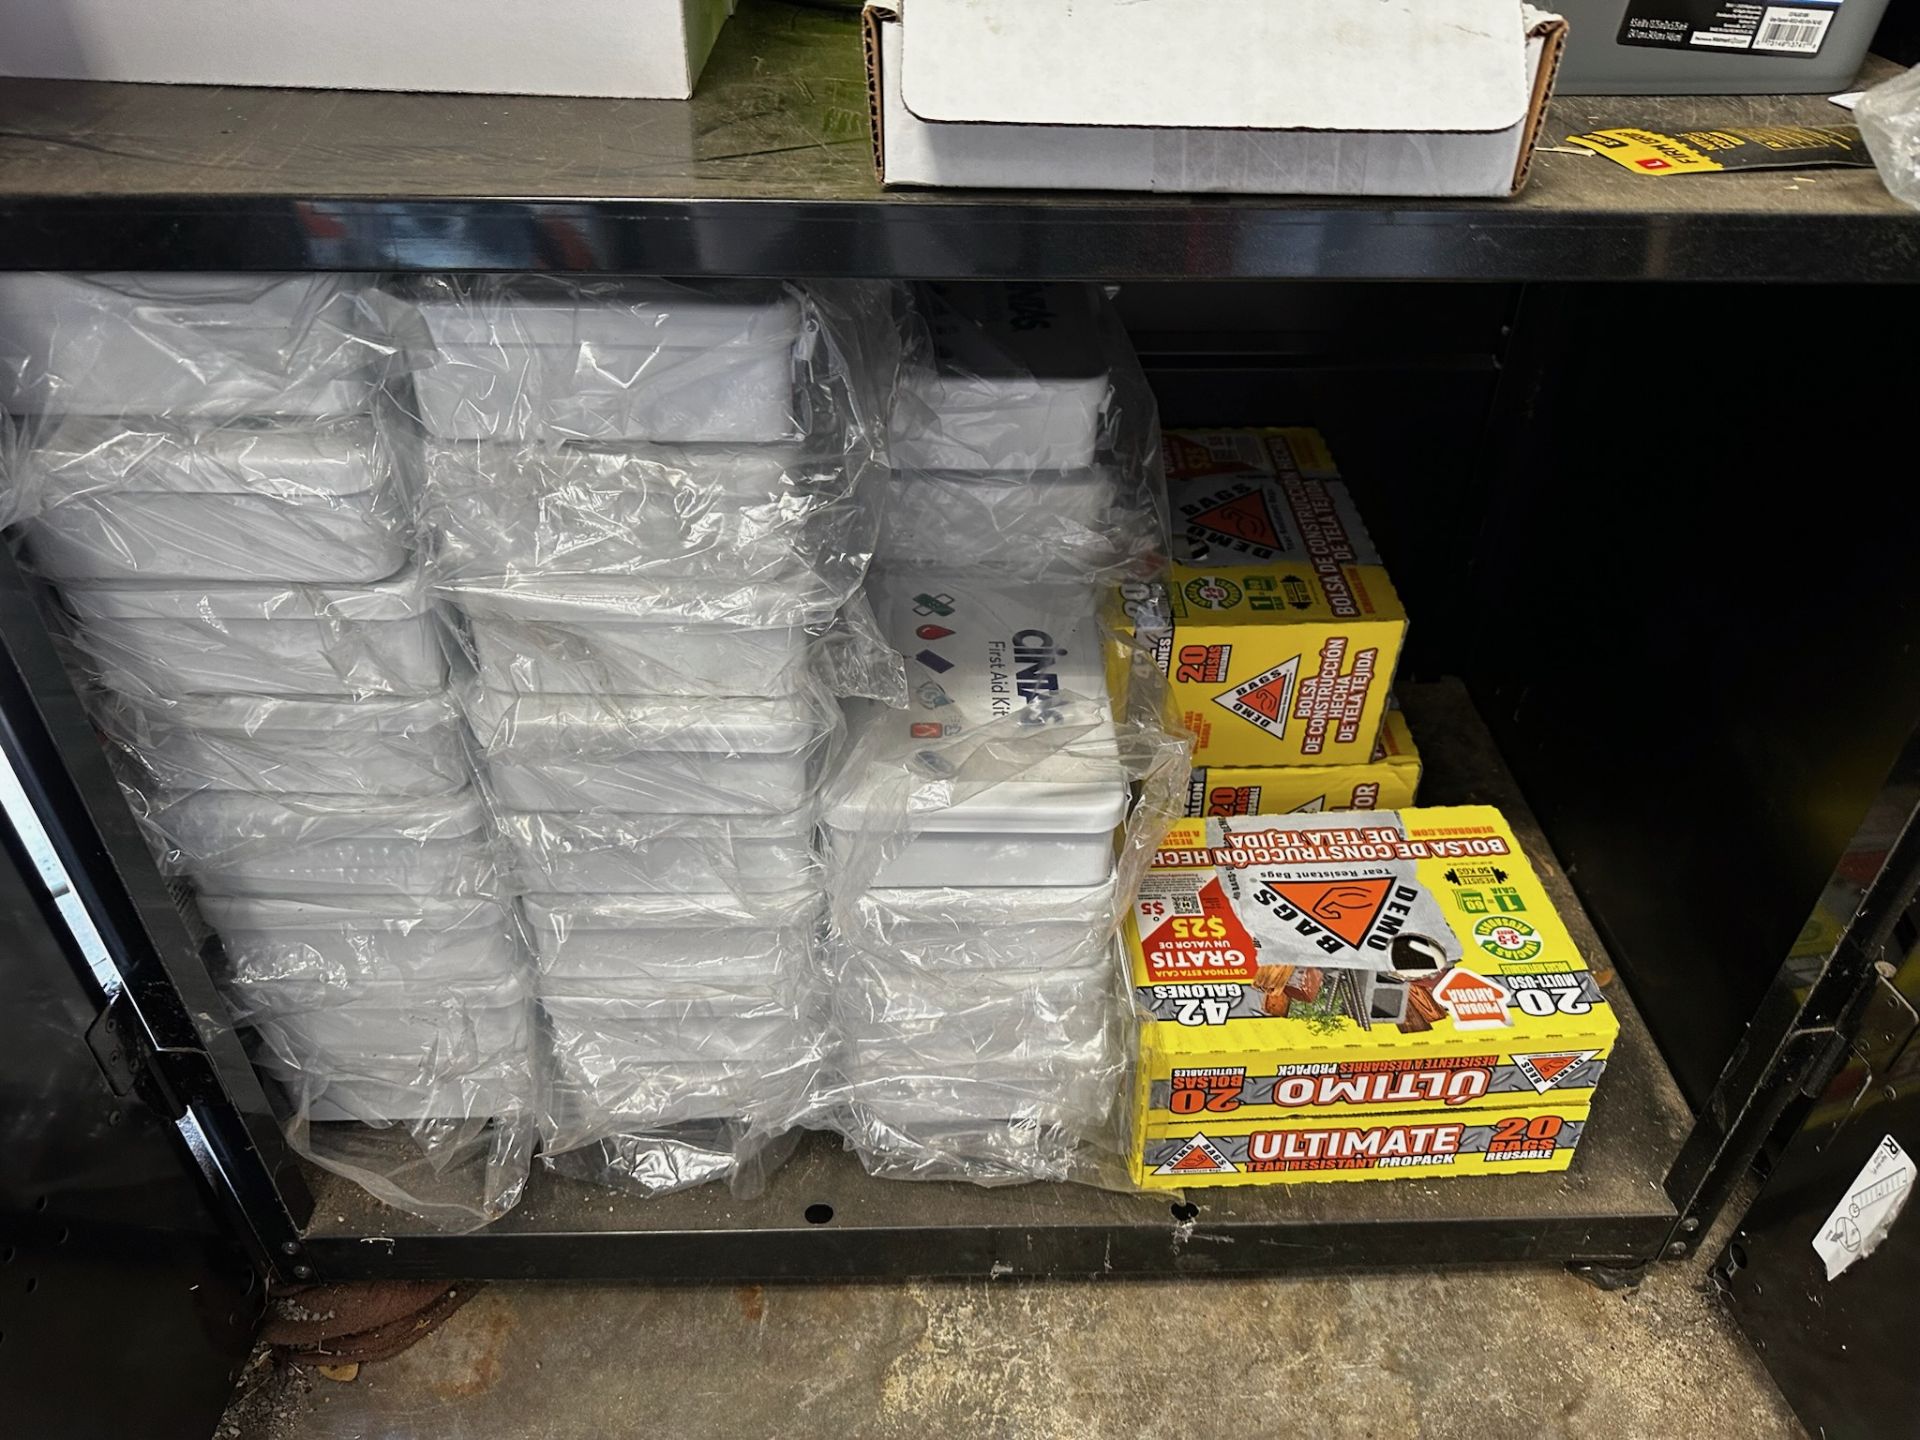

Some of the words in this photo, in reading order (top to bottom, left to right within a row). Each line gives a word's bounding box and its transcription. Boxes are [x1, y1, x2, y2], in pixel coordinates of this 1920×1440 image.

[1180, 483, 1251, 516] BAGS
[1322, 516, 1344, 542] TELA
[1187, 526, 1273, 560] DEMO
[1335, 543, 1351, 560] DE
[1319, 556, 1335, 573] DE
[1329, 576, 1355, 615] BOLSA
[988, 641, 1006, 669] First
[1178, 645, 1207, 683] 20
[1204, 646, 1221, 682] BOLSAS
[1348, 650, 1375, 691] TEJIDA
[991, 671, 1010, 696] Aid
[1235, 669, 1281, 696] BAGS
[1309, 638, 1344, 735] CONSTRUCCIÓN
[1296, 678, 1318, 718] BOLSA
[1329, 676, 1351, 718] HECHA
[992, 697, 1011, 717] Kit
[1233, 703, 1271, 728] DEMO
[1343, 692, 1363, 723] TELA
[1338, 724, 1354, 741] DE
[1305, 736, 1321, 753] DE
[1229, 832, 1303, 848] TEJIDA
[1307, 831, 1361, 845] TELA
[1366, 829, 1399, 843] DE
[1216, 845, 1393, 867] CONSTRUCCIÓN
[1400, 844, 1429, 858] DE
[1430, 838, 1505, 856] BOLSA
[1260, 871, 1293, 880] Bags
[1298, 869, 1358, 879] Resistant
[1364, 867, 1392, 876] Tear
[1141, 900, 1165, 916] $5
[1503, 896, 1519, 911] 1
[1172, 915, 1227, 939] $25
[1253, 888, 1345, 954] BAGS
[1159, 941, 1173, 949] DE
[1214, 940, 1231, 948] UN
[1498, 935, 1520, 945] 3-5
[1150, 949, 1246, 968] GRATIS
[1181, 969, 1203, 977] ESTA
[1204, 968, 1248, 976] OBTENGA
[1510, 973, 1579, 989] MULTI-USO
[1153, 983, 1242, 999] GALONES
[1449, 988, 1495, 1001] AHORA
[1458, 1002, 1501, 1015] PROBAR
[1516, 988, 1591, 1016] 20
[1175, 999, 1230, 1026] 42
[1174, 1067, 1245, 1078] REUTILIZABLES
[1278, 1063, 1338, 1076] PROPACK
[1340, 1061, 1412, 1074] DESGARRES
[1414, 1060, 1424, 1070] A
[1424, 1056, 1497, 1070] RESISTENTE
[1521, 1061, 1542, 1084] BAGS
[1550, 1058, 1584, 1083] DEMO
[1173, 1076, 1243, 1089] BOLSAS
[1275, 1068, 1490, 1105] ÚLTIMO
[1171, 1089, 1242, 1114] 20
[1493, 1116, 1563, 1140] 20
[1251, 1125, 1462, 1160] ULTIMATE
[1490, 1139, 1555, 1152] BAGS
[1883, 1137, 1899, 1156] R
[1166, 1143, 1195, 1167] DEMO
[1202, 1143, 1227, 1166] BAGS
[1246, 1160, 1286, 1173] TEAR
[1287, 1158, 1376, 1172] RESISTANT
[1379, 1153, 1455, 1169] PROPACK
[1486, 1149, 1553, 1162] REUSABLE
